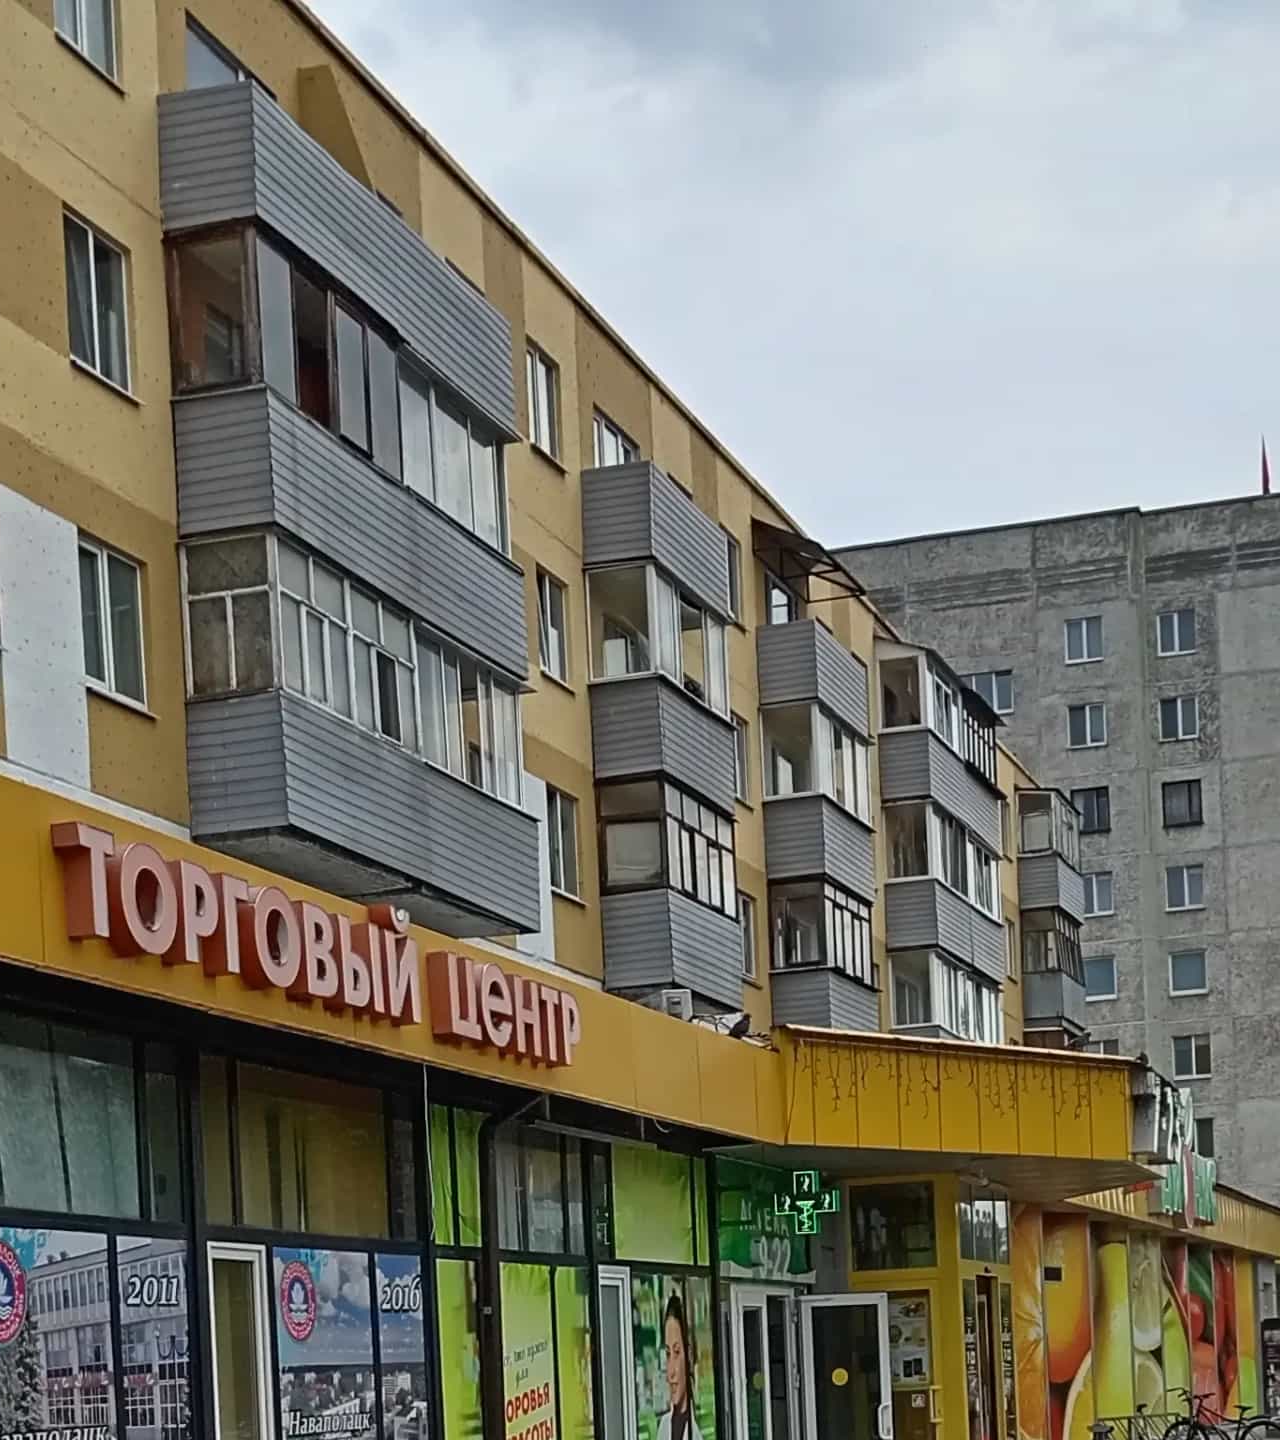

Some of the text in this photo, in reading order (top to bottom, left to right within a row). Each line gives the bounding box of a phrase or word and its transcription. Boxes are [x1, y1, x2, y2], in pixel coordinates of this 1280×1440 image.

[51, 821, 421, 1028] ТОРГОВЫЙ
[127, 1276, 178, 1305] 2011
[381, 1277, 421, 1310] 2016
[506, 1382, 551, 1423] ОРОВЬЯ
[288, 1410, 370, 1436] Наваполацк
